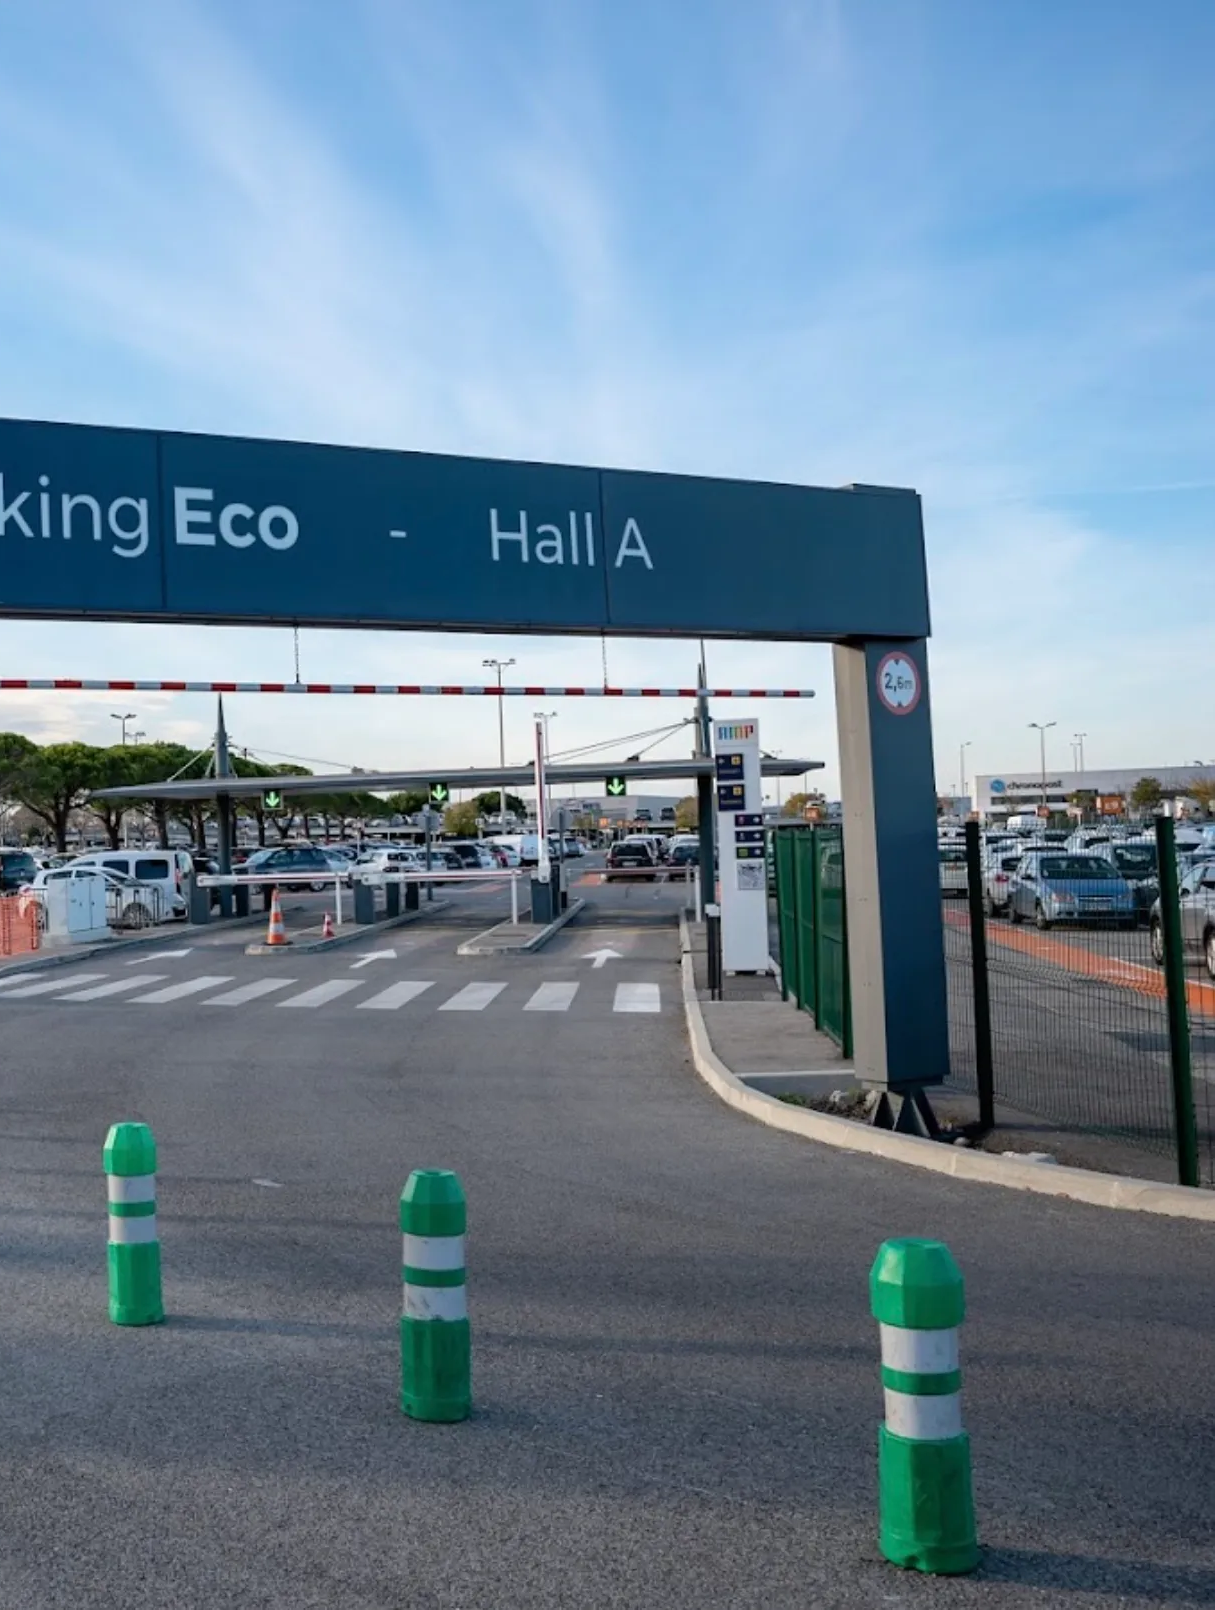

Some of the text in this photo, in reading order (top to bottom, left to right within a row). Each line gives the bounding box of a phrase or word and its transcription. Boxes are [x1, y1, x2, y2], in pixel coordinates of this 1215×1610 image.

[174, 486, 299, 550] Eco
[489, 508, 594, 566] Hall
[614, 517, 654, 570] A
